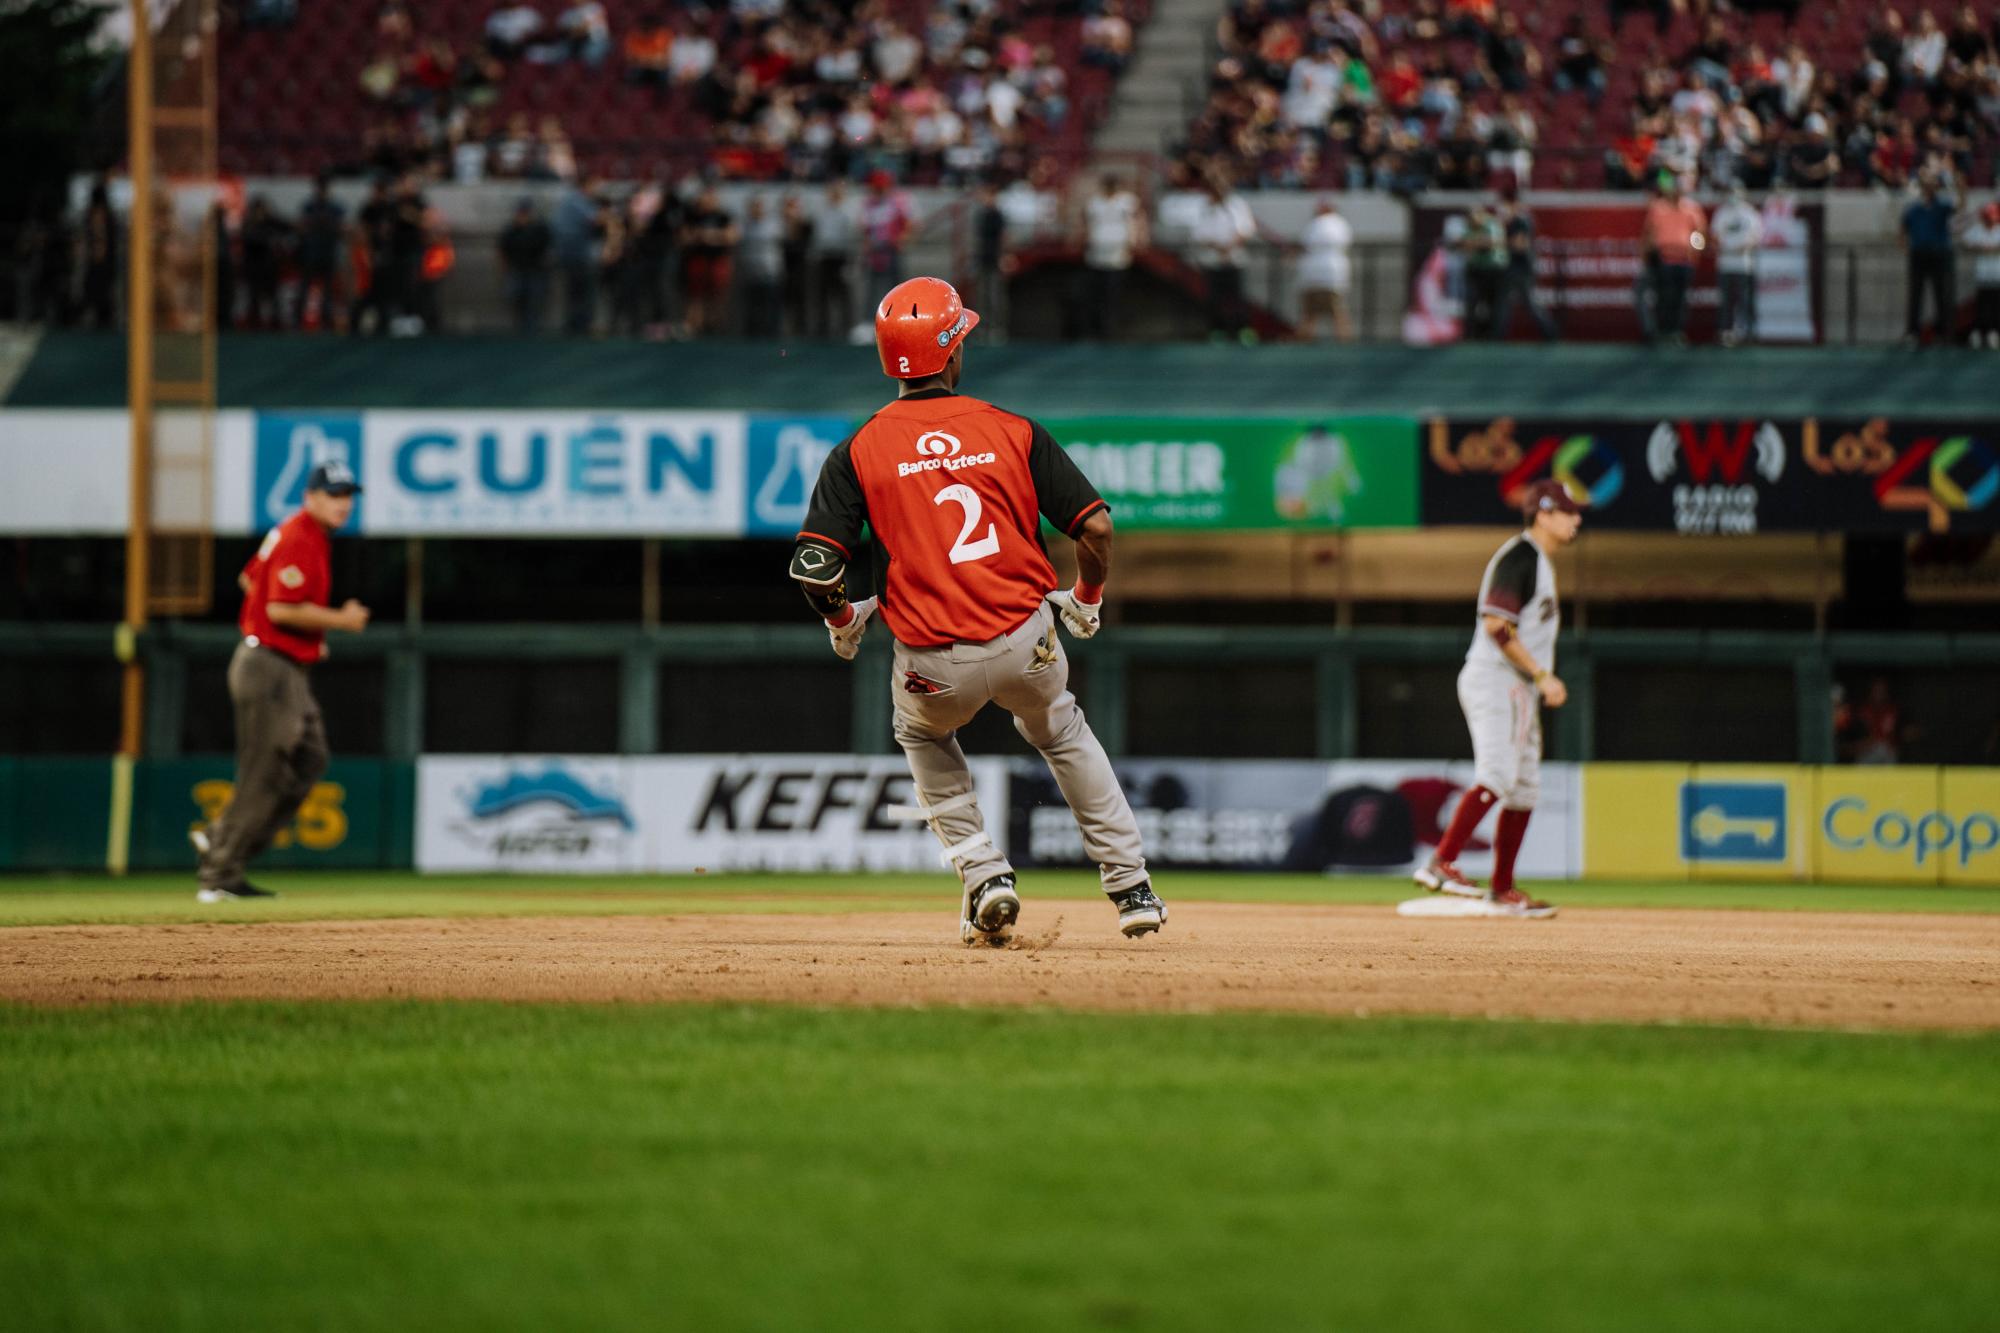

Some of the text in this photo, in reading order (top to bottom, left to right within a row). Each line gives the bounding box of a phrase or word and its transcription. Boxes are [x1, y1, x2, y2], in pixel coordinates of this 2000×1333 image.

[899, 356, 910, 372] 2
[392, 416, 718, 494] CUÉN
[898, 452, 996, 477] Banco Azteca
[1676, 419, 1757, 484] W
[933, 483, 1001, 565] 2
[191, 778, 348, 850] 35
[695, 771, 976, 831] KEFE
[1822, 797, 2000, 865] Copp
